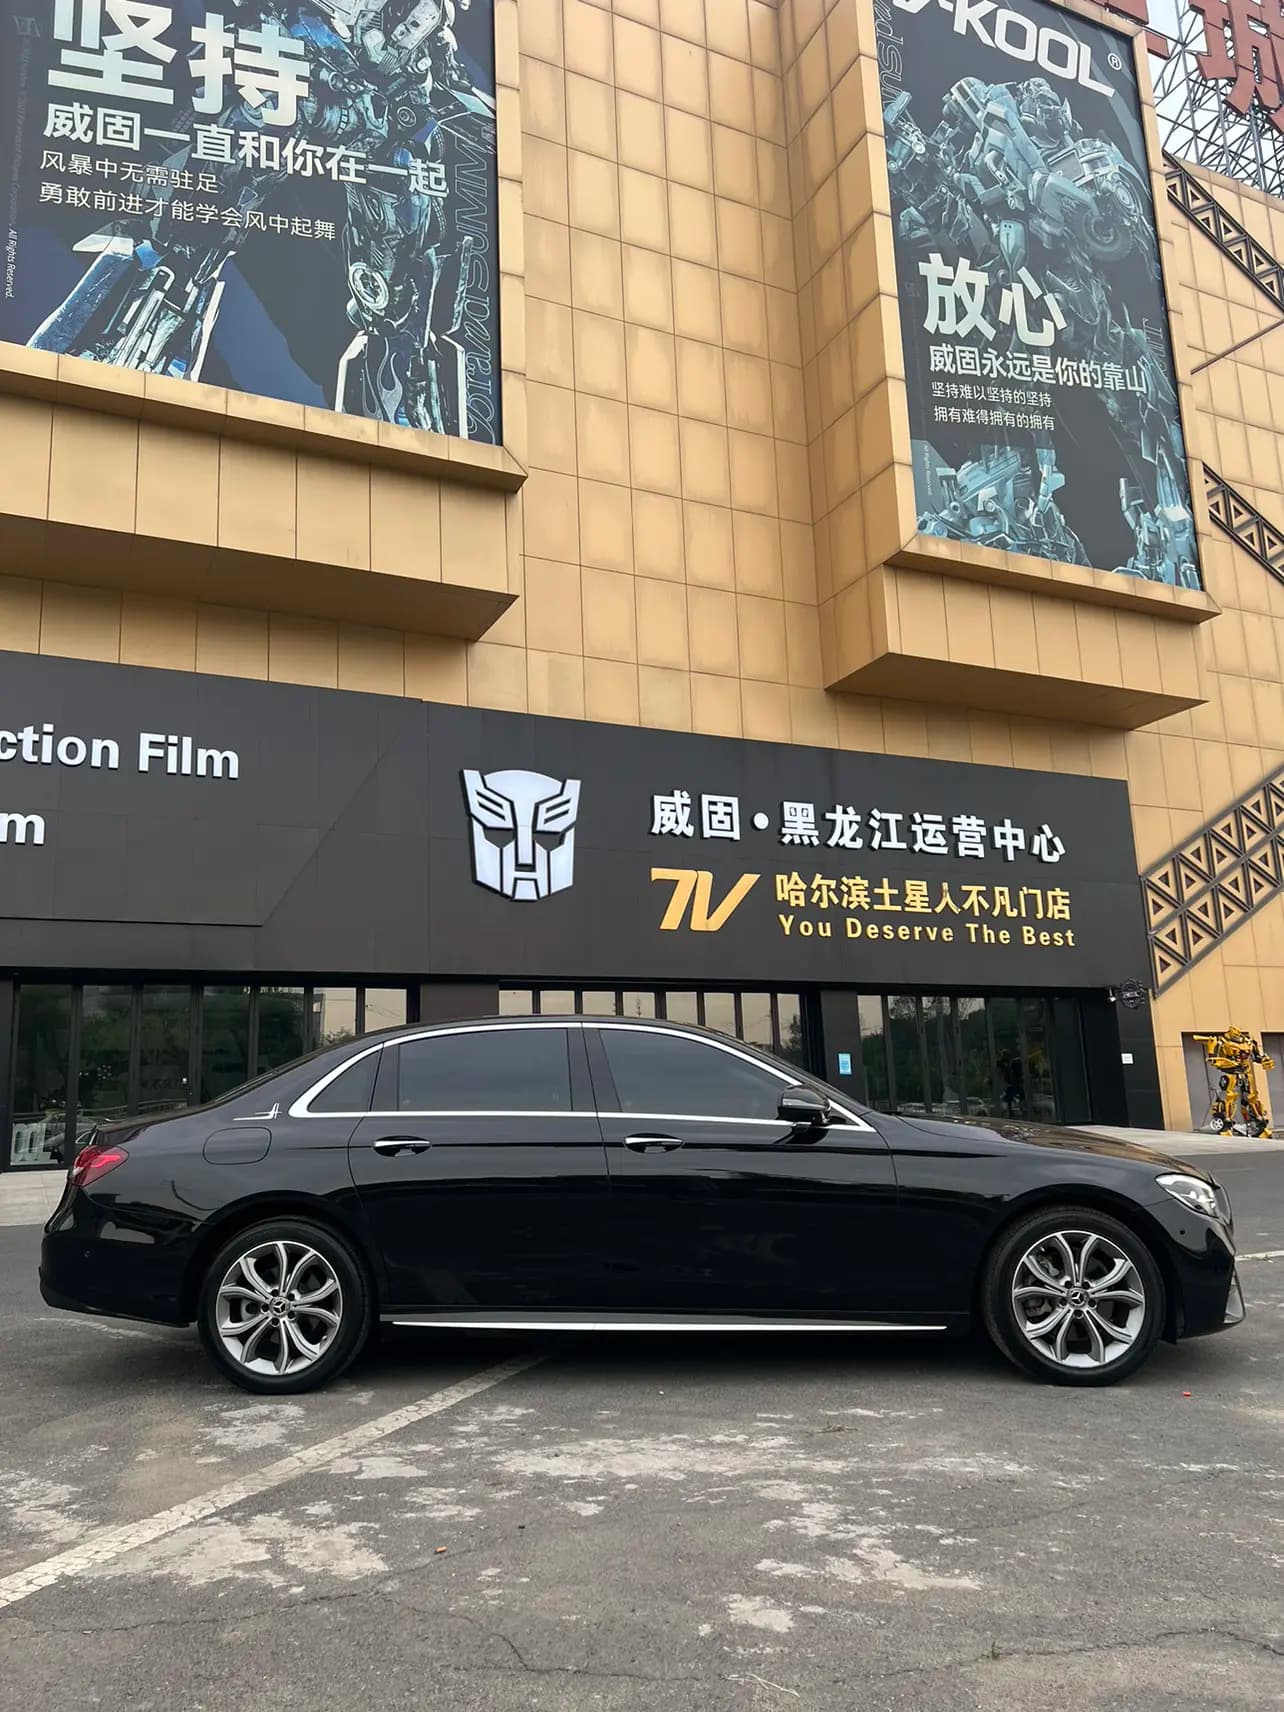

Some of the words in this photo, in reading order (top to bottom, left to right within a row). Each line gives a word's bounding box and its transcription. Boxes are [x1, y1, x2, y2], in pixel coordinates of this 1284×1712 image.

[47, 0, 312, 127] 坚持
[893, 0, 1116, 97] -KOOL
[39, 150, 219, 195] 风暴中无需驻足
[43, 102, 448, 199] 威固一直和你在一起
[38, 182, 337, 241] 勇敢前进才能学会风中起舞
[918, 253, 1067, 347] 放心
[929, 343, 1147, 395] 威固永远是你的靠山
[931, 381, 1053, 408] 坚持难以坚持的坚持
[933, 405, 1056, 432] 拥有难得拥有的拥有
[0, 723, 119, 769] ction
[138, 732, 239, 779] Film
[775, 872, 1071, 920] 哈尔滨土星人不凡门店
[778, 914, 832, 938] You
[846, 917, 955, 942] Deserve
[965, 923, 1011, 944] The
[1022, 925, 1076, 947] Best
